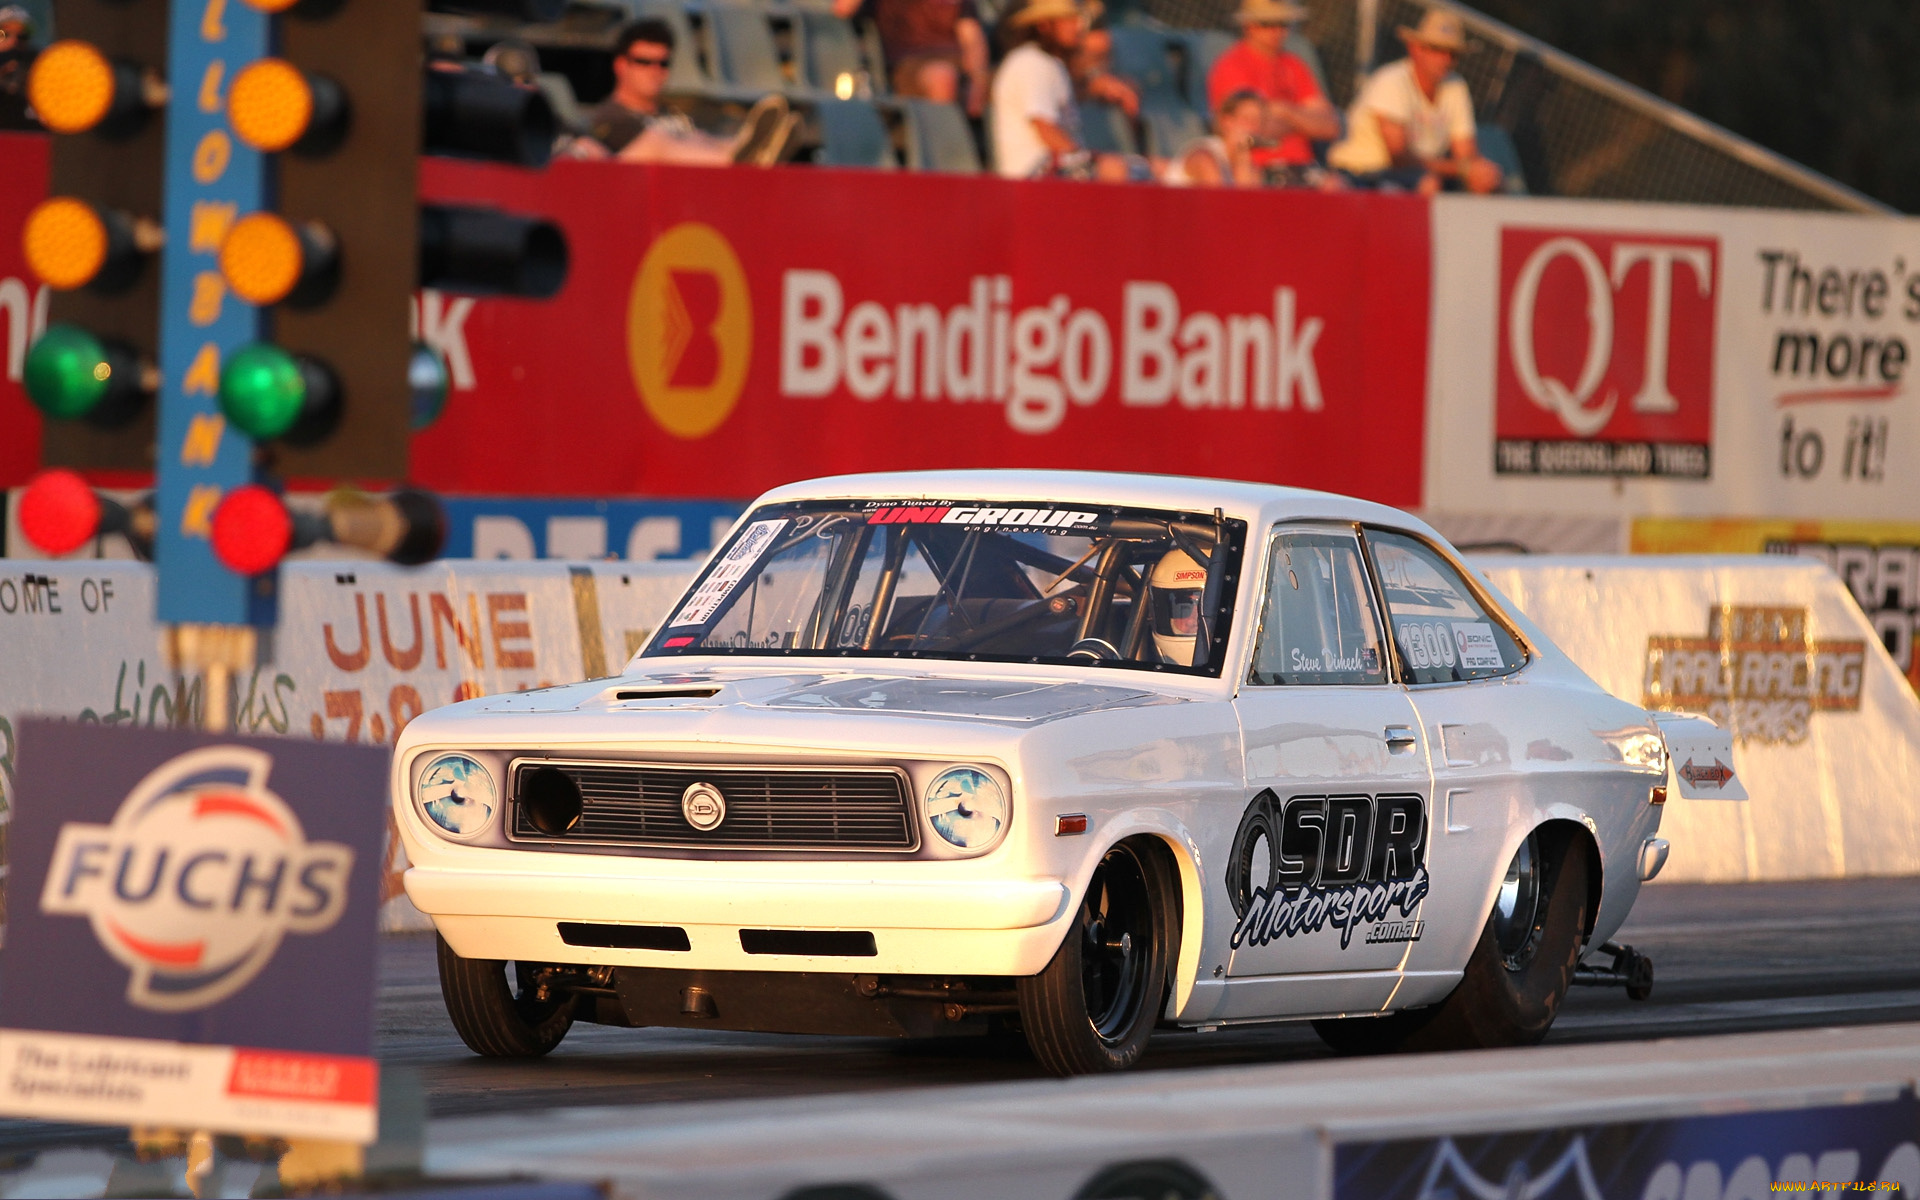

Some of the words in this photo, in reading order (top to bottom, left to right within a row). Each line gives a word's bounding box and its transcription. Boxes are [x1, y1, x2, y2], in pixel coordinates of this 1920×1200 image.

[780, 268, 1113, 434] Bendigo
[1121, 280, 1324, 412] Bank
[1508, 237, 1712, 436] QT
[1771, 329, 1908, 382] more
[1781, 414, 1823, 477] to
[1843, 417, 1888, 481] it!
[865, 501, 898, 509] Dyno
[939, 500, 955, 508] By
[963, 526, 1068, 536] engineering
[80, 577, 116, 613] OF
[1175, 571, 1205, 580] SIMPSON
[323, 592, 536, 672] JUNE
[1398, 622, 1456, 669] 1300
[1291, 647, 1321, 671] Steve
[1325, 648, 1363, 671] Dimech
[1278, 793, 1427, 890] SDR
[62, 841, 346, 919] FUCHS
[1230, 864, 1429, 949] Motorsport
[1366, 920, 1424, 944] .com.au
